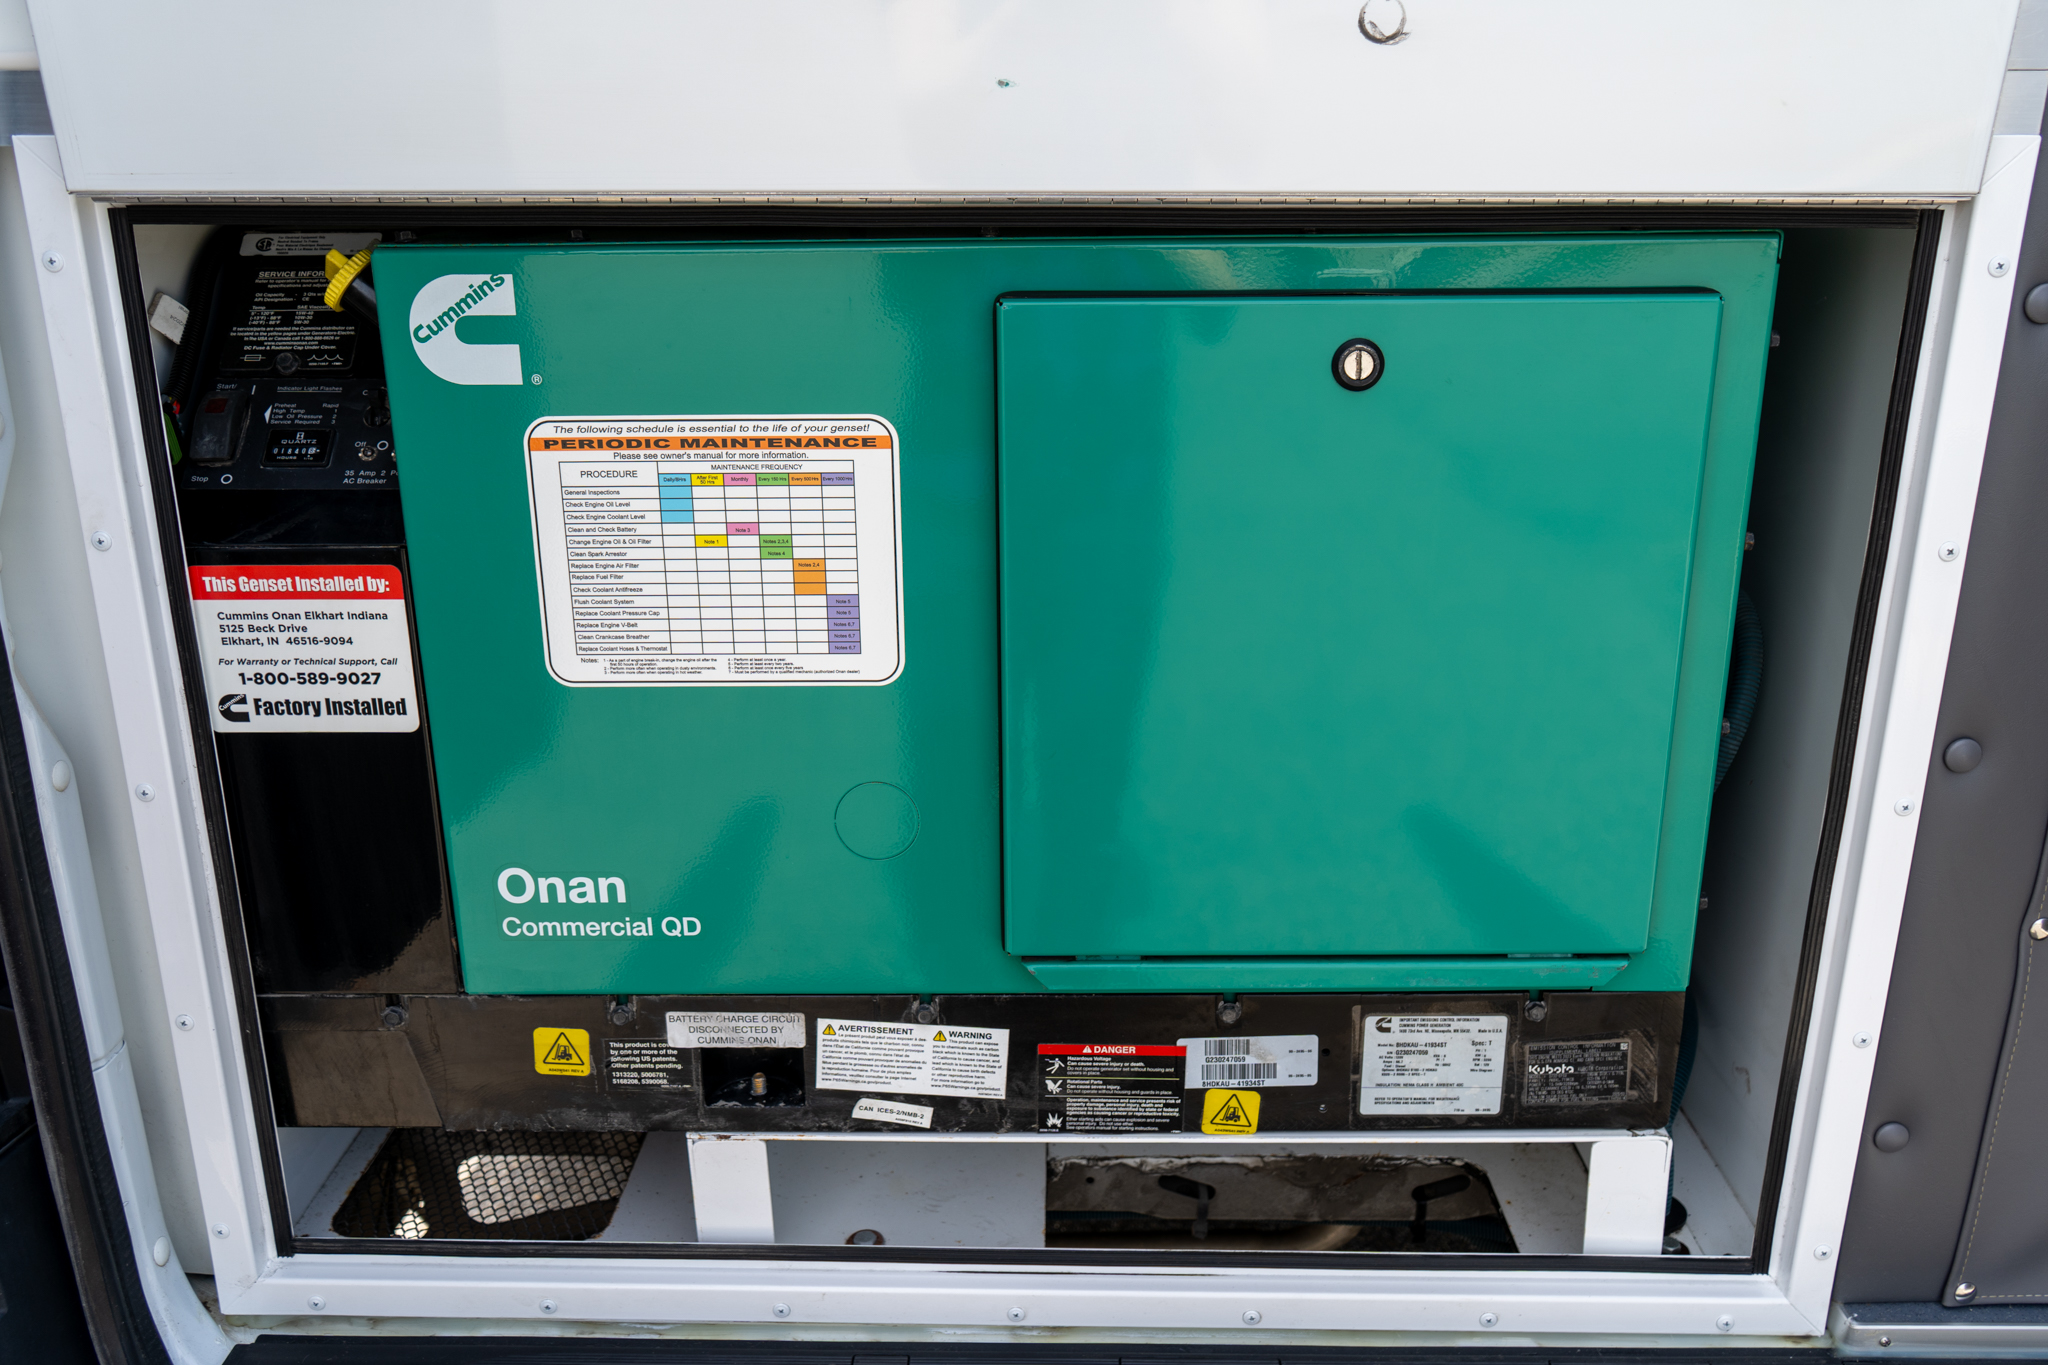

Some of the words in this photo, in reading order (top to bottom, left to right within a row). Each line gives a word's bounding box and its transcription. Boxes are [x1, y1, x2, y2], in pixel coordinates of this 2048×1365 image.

[413, 274, 505, 343] Cummins
[553, 425, 574, 434] The
[577, 425, 623, 435] following
[626, 425, 674, 433] schedule
[677, 425, 686, 433] is
[689, 424, 737, 433] essential
[752, 424, 769, 433] the
[772, 424, 788, 433] life
[790, 424, 802, 432] of
[804, 425, 828, 434] your
[830, 424, 870, 434] genset!
[543, 439, 670, 450] PERIODIC
[680, 438, 877, 448] MAINTENANCE
[613, 452, 641, 460] Please
[660, 452, 692, 460] owner's
[693, 451, 724, 460] manual
[725, 451, 737, 459] for
[761, 450, 809, 459] information.
[580, 470, 638, 478] PROCEDURE
[571, 572, 595, 581] Replace
[202, 577, 236, 592] This
[238, 576, 294, 592] Genset
[295, 576, 364, 592] Installed
[366, 576, 390, 593] by:
[217, 611, 269, 621] Cummins
[271, 611, 302, 620] Onan
[304, 611, 344, 620] Elkhart
[347, 611, 388, 620] Indiana
[219, 624, 245, 633] 5125
[247, 624, 276, 633] Beck
[278, 624, 308, 633] Drive
[221, 637, 264, 647] Elkhart,
[267, 637, 280, 646] IN
[286, 636, 354, 646] 46516-9094
[236, 658, 279, 667] Warranty
[338, 658, 378, 667] Support,
[238, 672, 381, 685] 1-800-589-9027
[219, 694, 245, 711] Cummins
[253, 698, 321, 718] Factory
[325, 698, 407, 716] Installed
[498, 868, 626, 904] Onan
[502, 917, 653, 936] Commercial
[662, 917, 701, 937] QD
[770, 1026, 784, 1034] BY
[838, 1025, 914, 1035] AVERTISSEMENT
[948, 1031, 992, 1040] WARNING
[747, 1036, 777, 1045] ONAN
[1094, 1045, 1136, 1054] DANGER
[1529, 1064, 1574, 1075] Kubota
[877, 1106, 925, 1120] ICES-2/NMB-2
